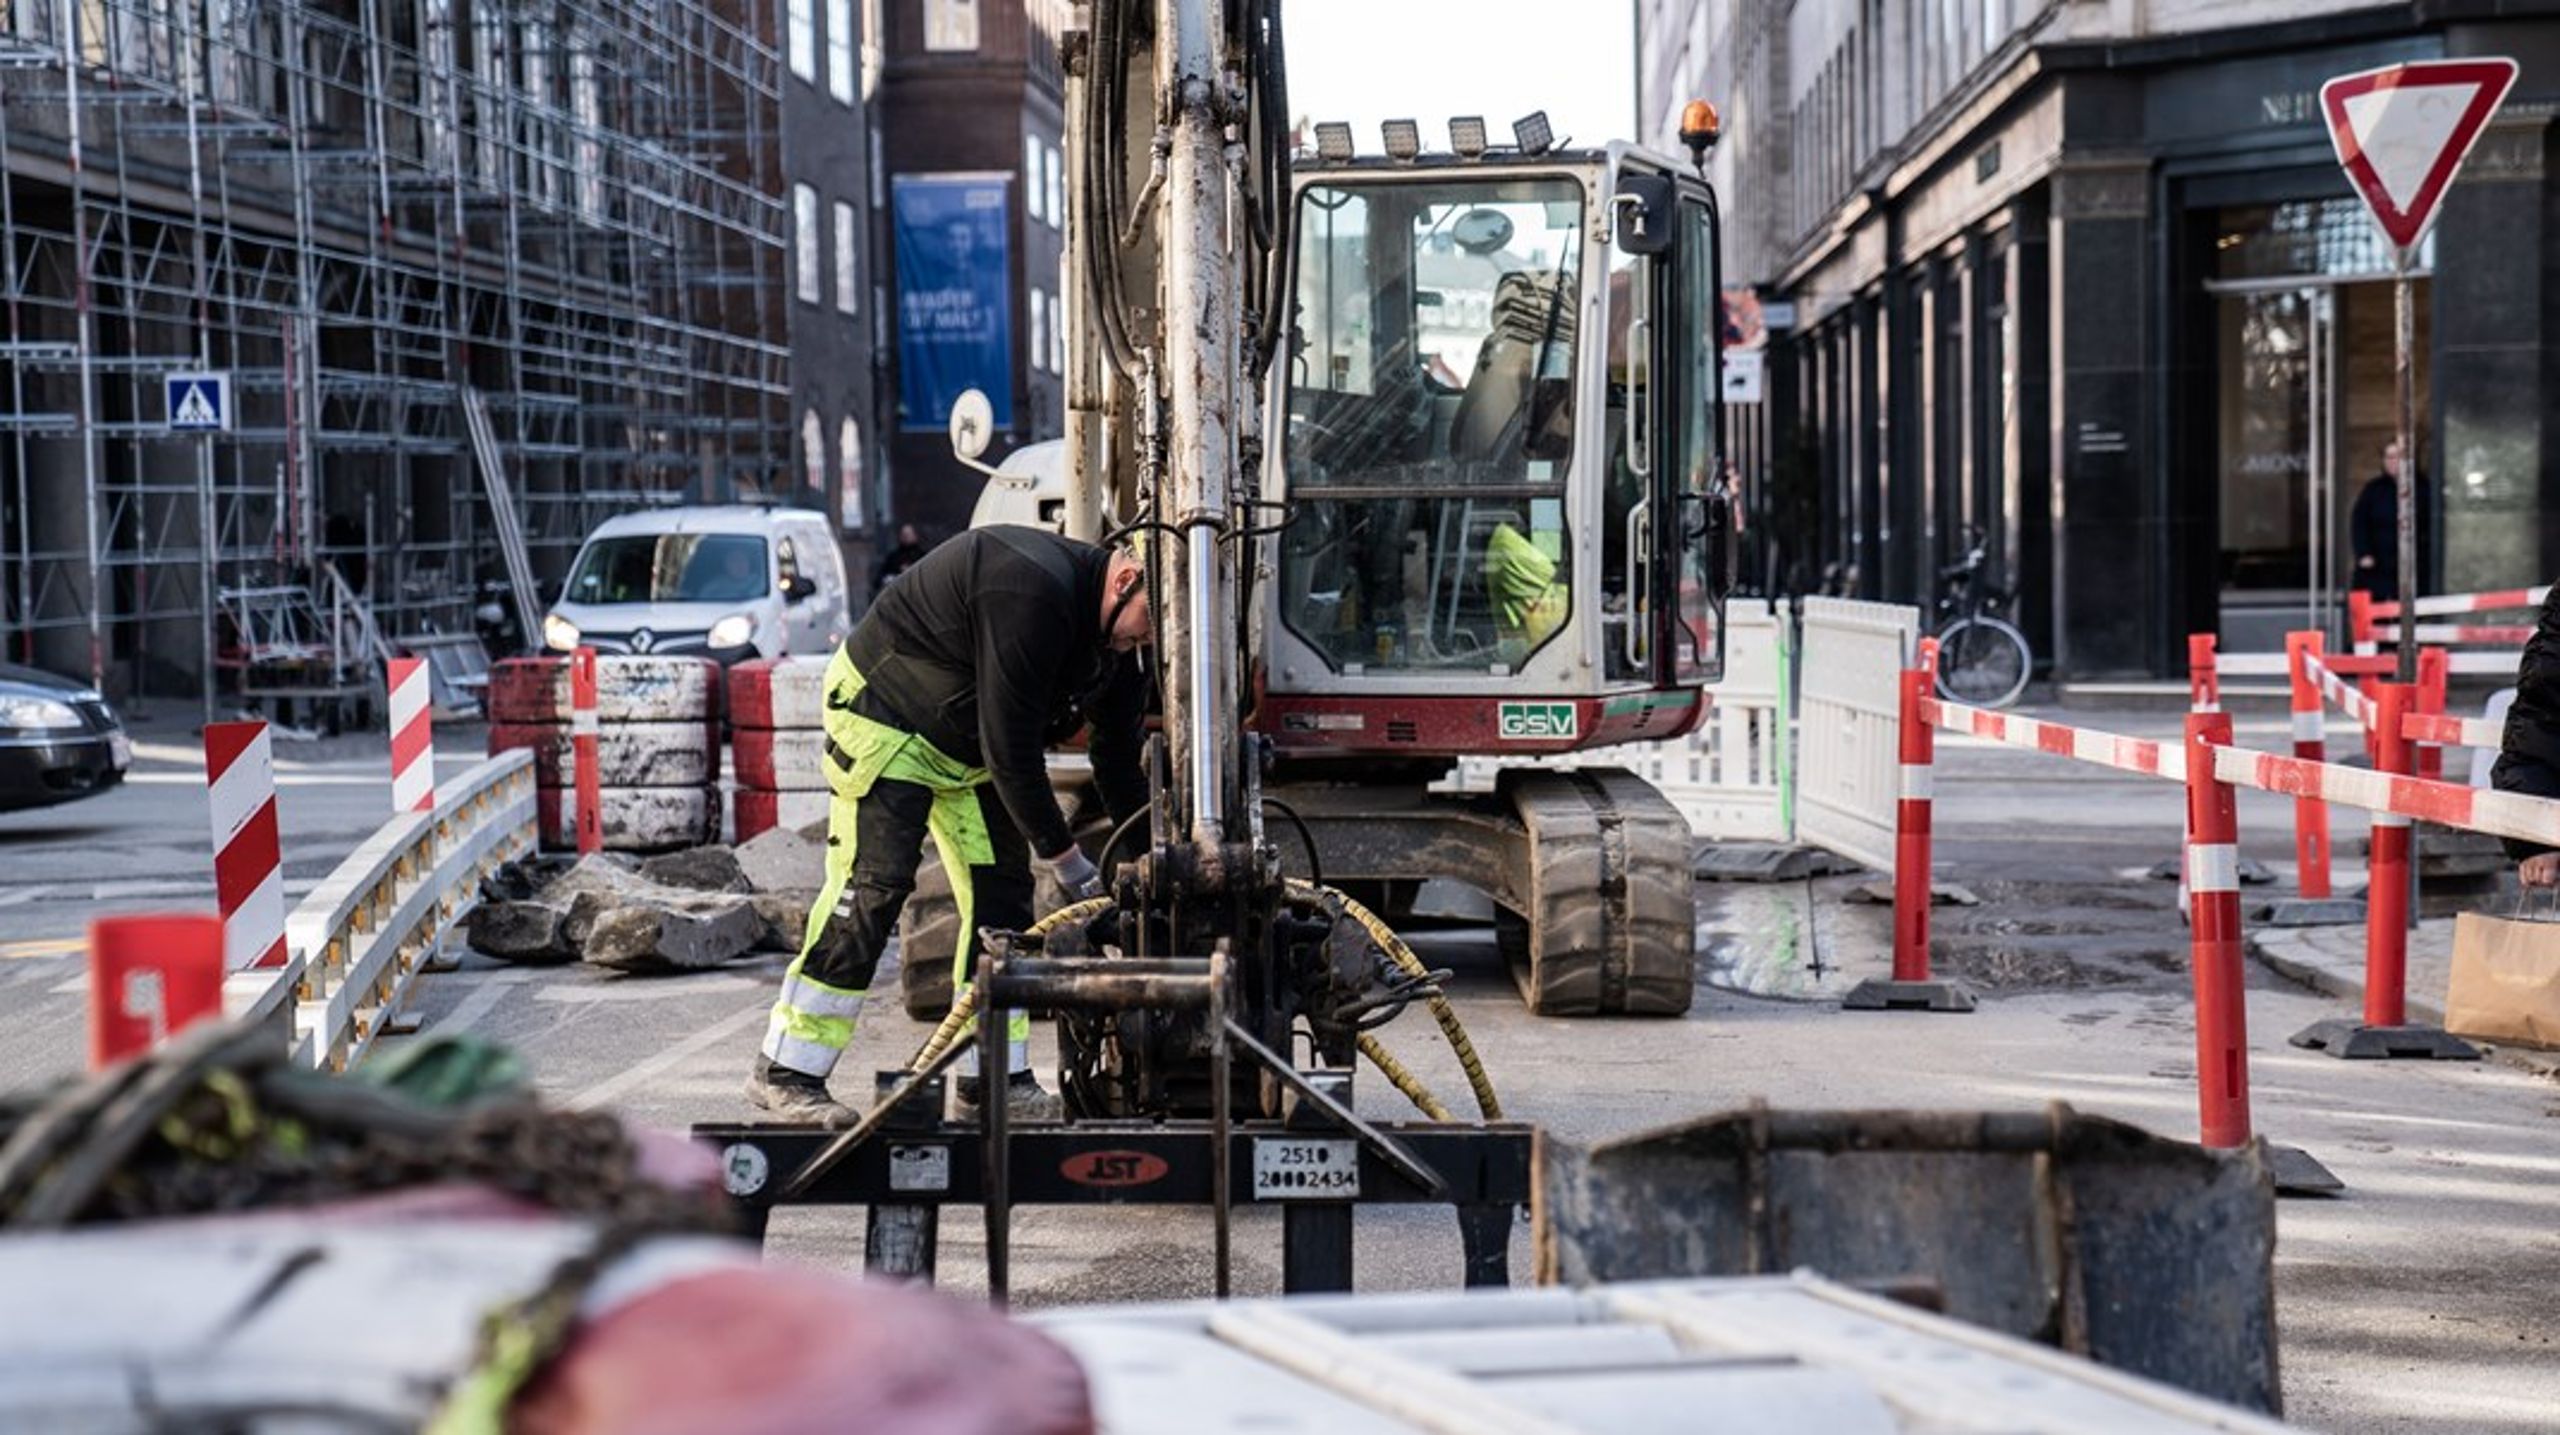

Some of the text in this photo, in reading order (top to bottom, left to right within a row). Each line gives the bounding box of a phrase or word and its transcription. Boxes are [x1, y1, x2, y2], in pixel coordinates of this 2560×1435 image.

[1503, 714, 1572, 733] GSV
[1280, 1146, 1329, 1165] 2510
[1086, 1157, 1143, 1180] JST
[1258, 1170, 1355, 1188] 20002434
